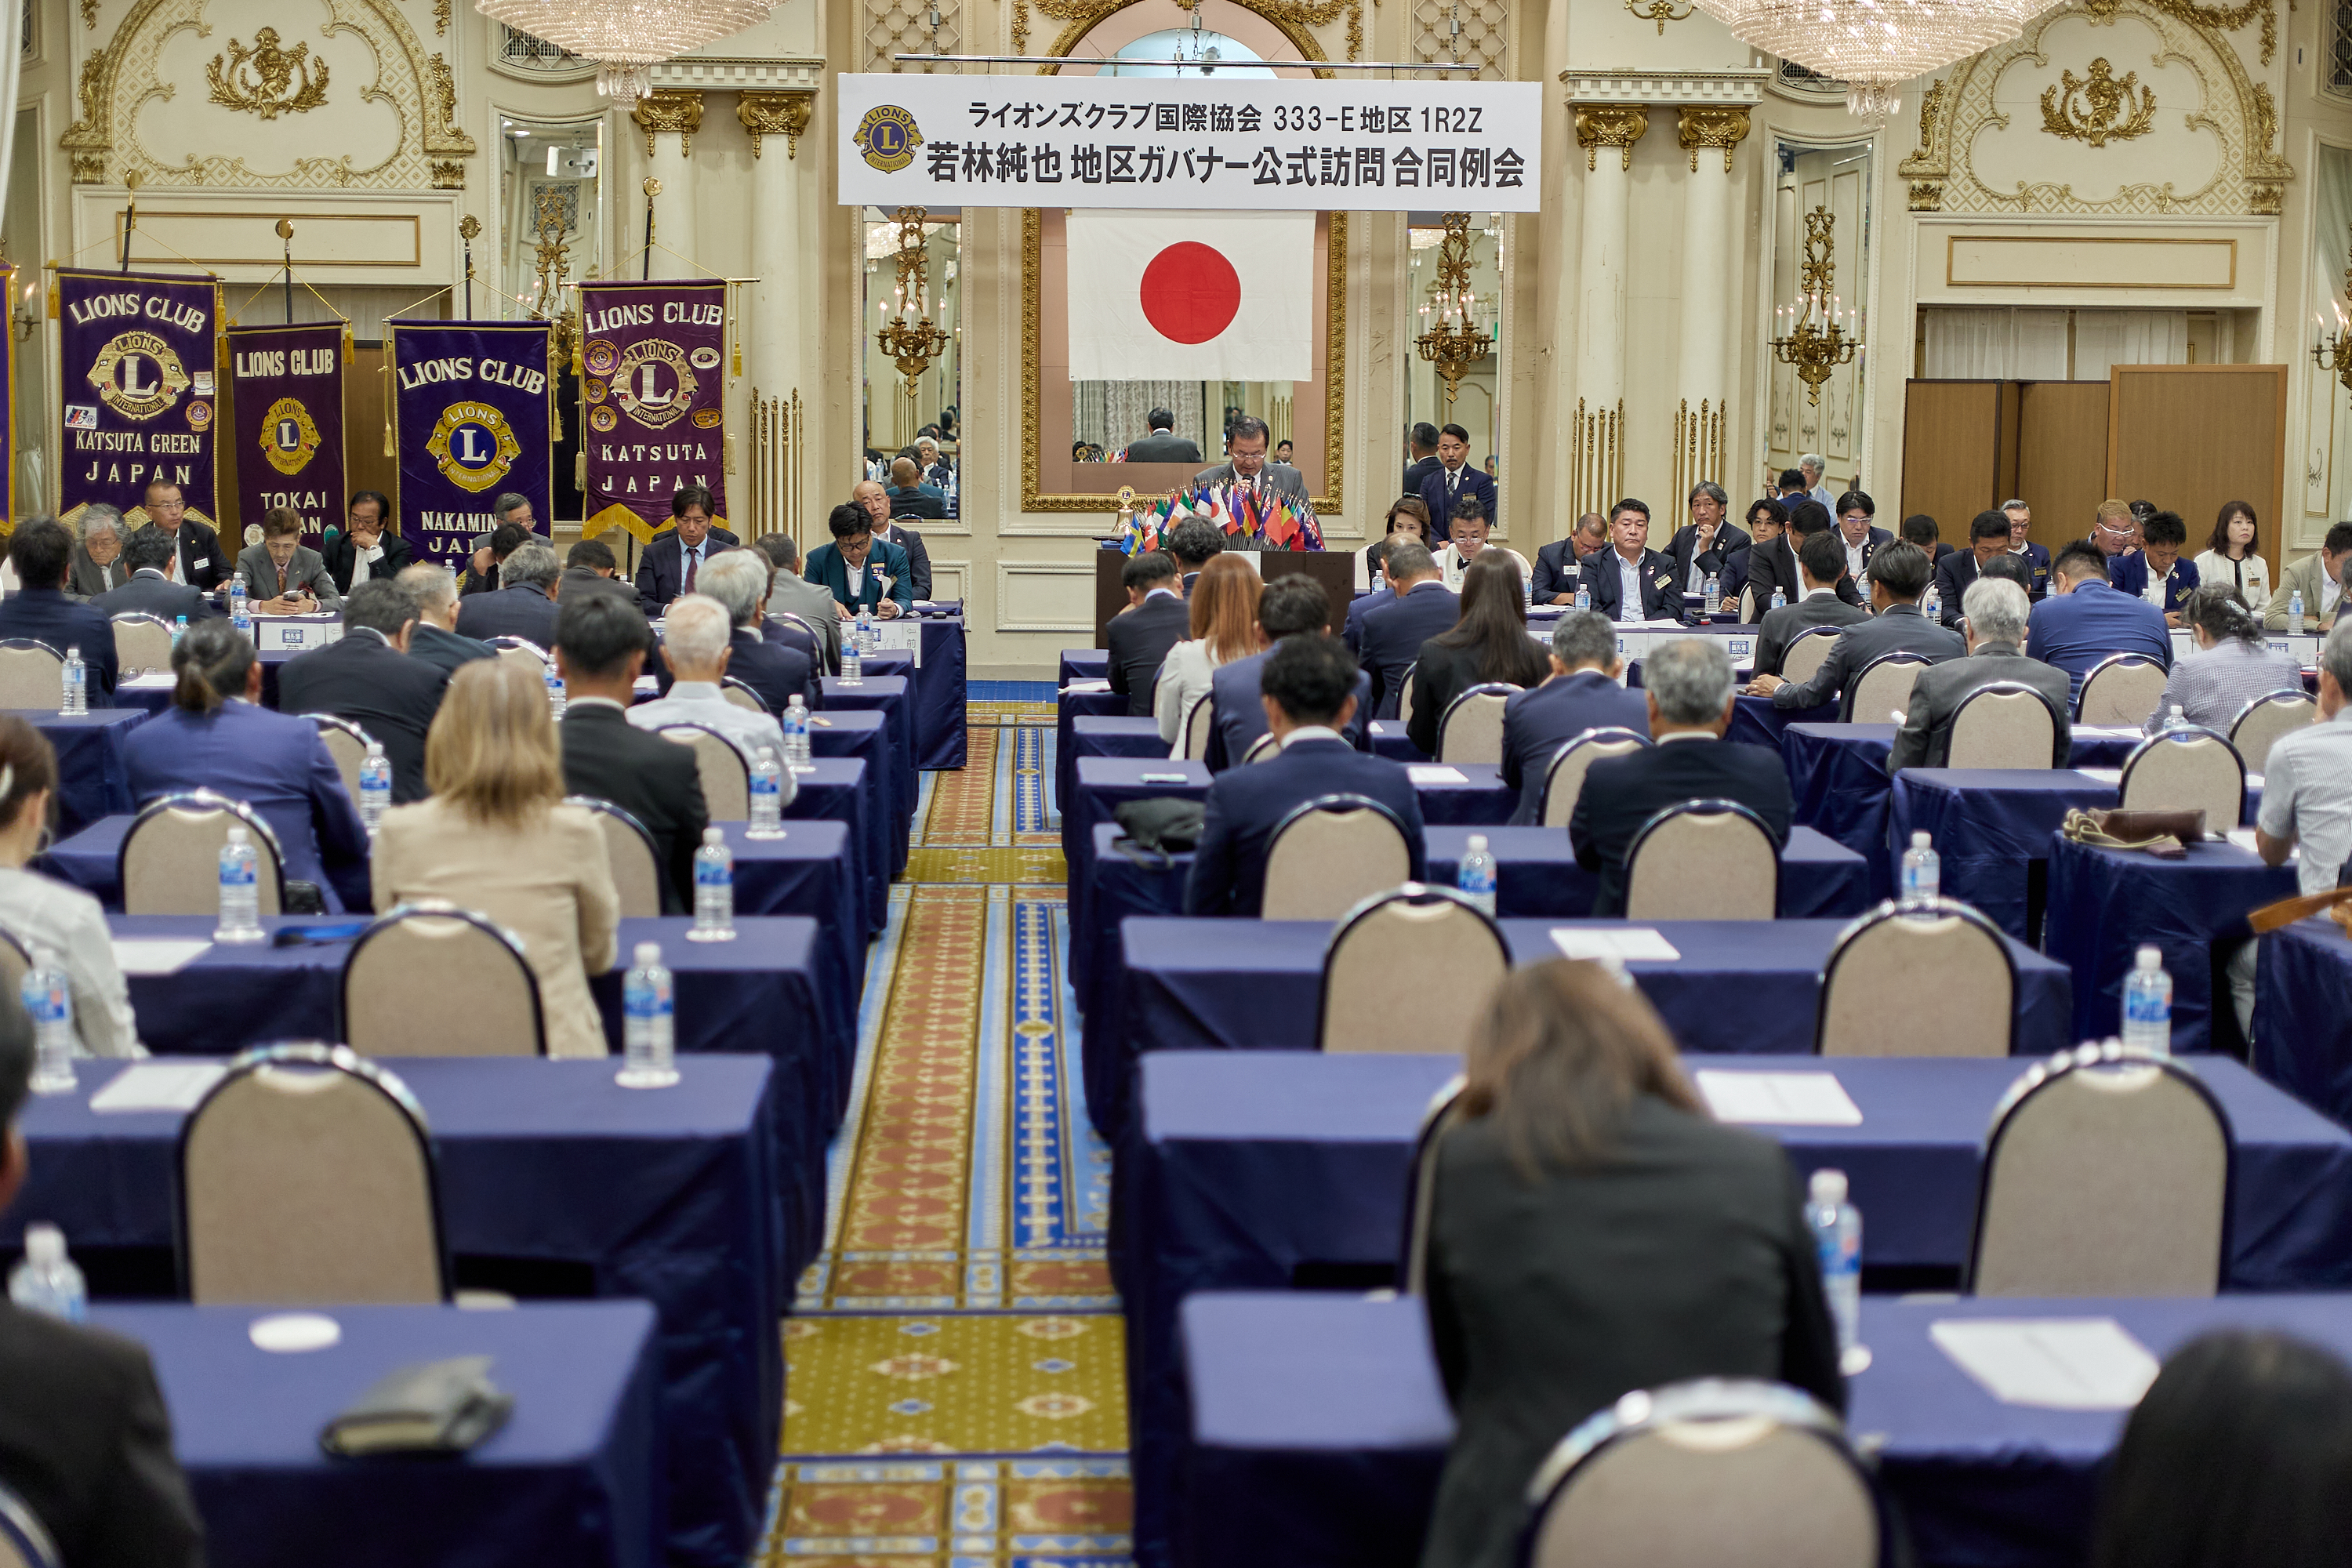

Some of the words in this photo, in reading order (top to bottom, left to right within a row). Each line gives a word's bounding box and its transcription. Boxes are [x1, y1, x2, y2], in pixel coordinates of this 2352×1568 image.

[869, 107, 909, 122] LIONS
[968, 101, 1262, 132] ライオンズクラブ国際協会
[880, 126, 899, 149] L
[869, 155, 909, 168] INTERNATIONAL
[68, 293, 140, 325] LIONS
[145, 296, 205, 333] CLUB
[585, 303, 654, 334] LIONS
[663, 302, 724, 326] CLUB
[117, 336, 162, 354] LIONS
[631, 343, 678, 361] LIONS
[237, 350, 285, 377] LIONS
[290, 348, 334, 376] CLUB
[122, 355, 158, 396] L
[397, 358, 473, 390] LIONS
[479, 358, 546, 394] CLUB
[640, 365, 673, 403] L
[113, 395, 164, 413] INTERNATIONAL
[274, 403, 302, 418] LIONS
[633, 405, 680, 423] INTERNATIONAL
[448, 406, 498, 426] LIONS
[75, 430, 144, 452] KATSUTA
[151, 434, 201, 454] GREEN
[279, 423, 297, 448] L
[459, 429, 487, 461] L
[601, 442, 706, 462] KATSUTA
[85, 461, 191, 485] JAPAN
[448, 466, 499, 483] INTERNATIONAL
[601, 474, 707, 492] JAPAN
[260, 492, 326, 510] TOKAI
